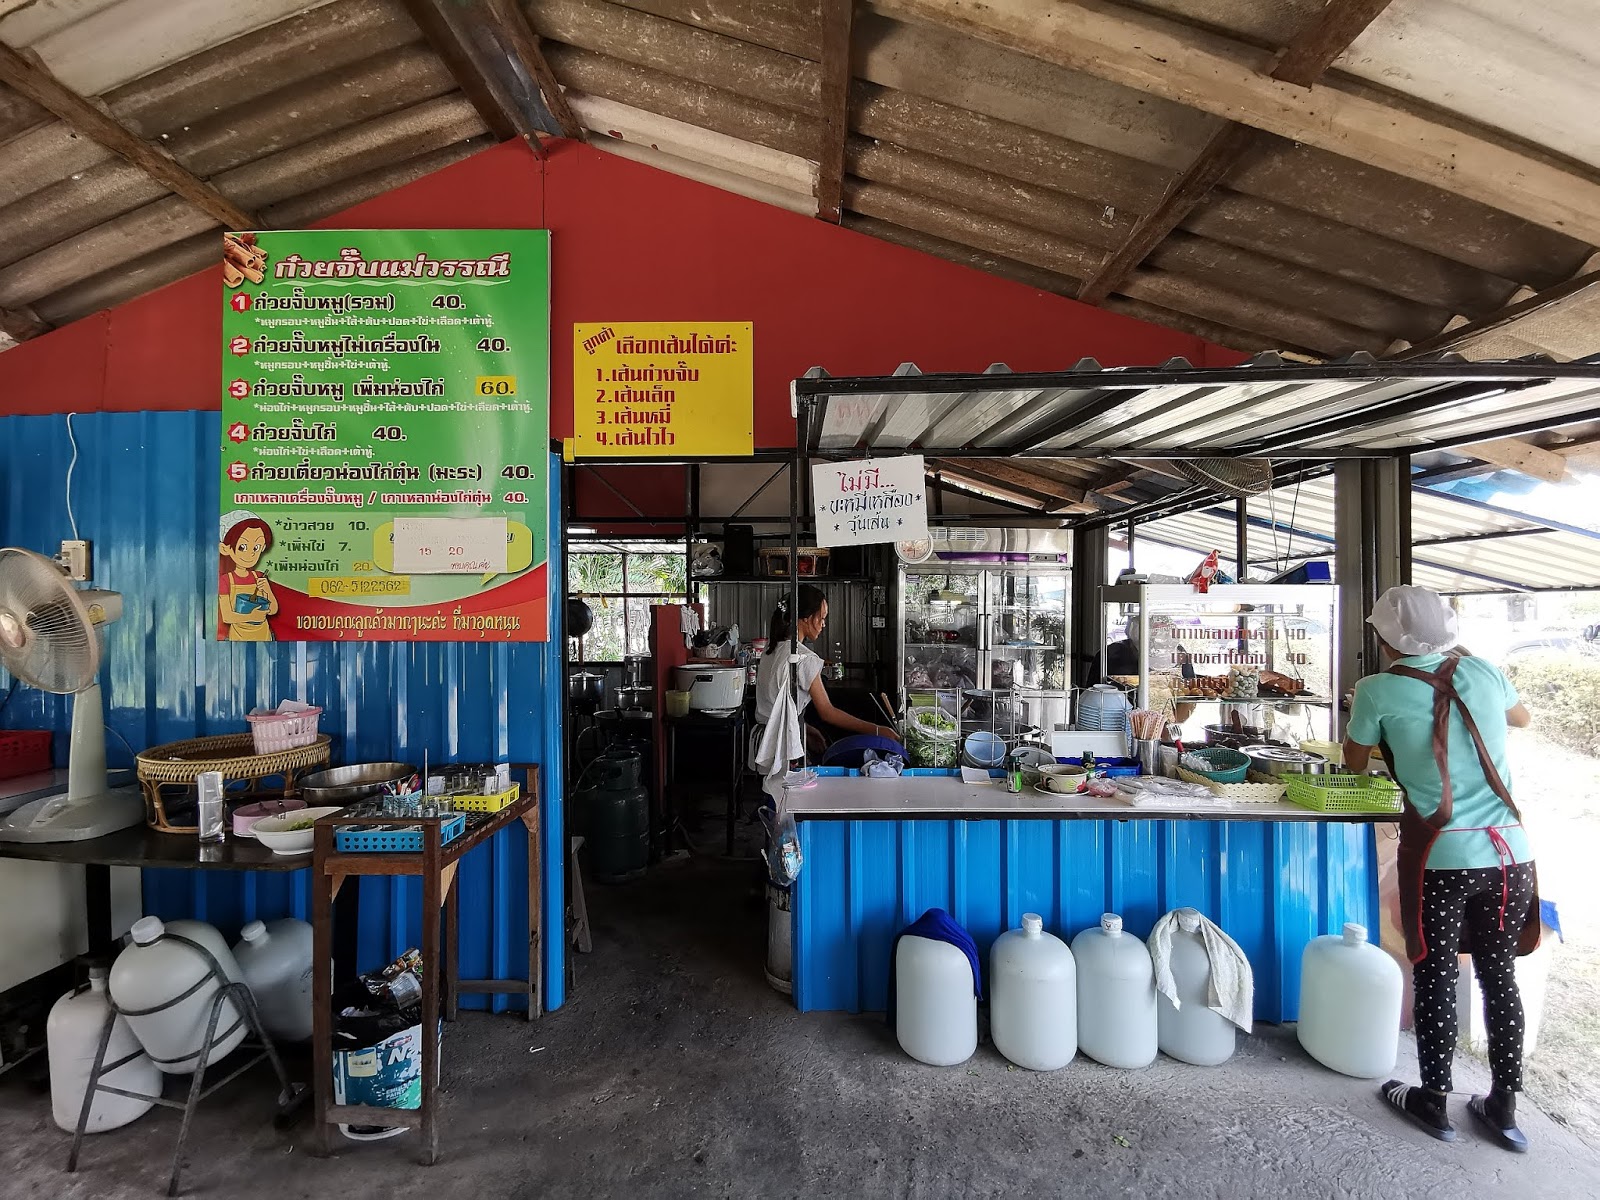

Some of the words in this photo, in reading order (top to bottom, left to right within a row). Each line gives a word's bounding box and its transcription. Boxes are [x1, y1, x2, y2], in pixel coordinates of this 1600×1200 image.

[274, 247, 511, 278] ก๋วยจั๊บแม่วรรณี
[234, 295, 246, 310] 1
[253, 287, 395, 314] ก๋วยจั๊บหมู(รวม)
[431, 294, 466, 309] 40.
[233, 338, 248, 353] 2
[254, 330, 441, 358] ก๋วยจั๊บหมูไม่เครื่องใน
[476, 337, 511, 352] 40.
[582, 326, 616, 356] ลูกค้า
[616, 333, 737, 354] เลือกเส้นได้ค่ะ
[232, 381, 247, 396] 3
[253, 373, 344, 402] ก๋วยจั๊บหมู
[353, 375, 445, 397] เพิ่มน่องไก่
[480, 380, 514, 395] 60.
[596, 384, 675, 403] 2.เส้นเล็ก
[596, 403, 672, 424] 3.เส้นหมี่
[231, 425, 246, 440] 4
[252, 417, 337, 440] ก๋วยจั๊บไก่
[372, 426, 407, 441] 40.
[596, 426, 676, 446] 4.เส้นไวไว
[231, 463, 247, 479] 5
[251, 458, 420, 485] ก๋วยเตี๋ยวน่องไก่ตุ๋น
[428, 463, 482, 482] (มะระ)
[501, 465, 535, 479] 40.
[234, 487, 363, 507] เกาเหลาเครื่องจั๊บหมู
[381, 490, 492, 507] เกาเหลาน่องไก่ตุ๋น
[503, 491, 529, 504] 40.
[348, 521, 370, 531] 10.
[847, 511, 889, 536] วุ้นเส้น
[338, 541, 352, 552] 7.
[448, 546, 464, 556] 20
[452, 604, 521, 638] ที่มาอุดหนุน
